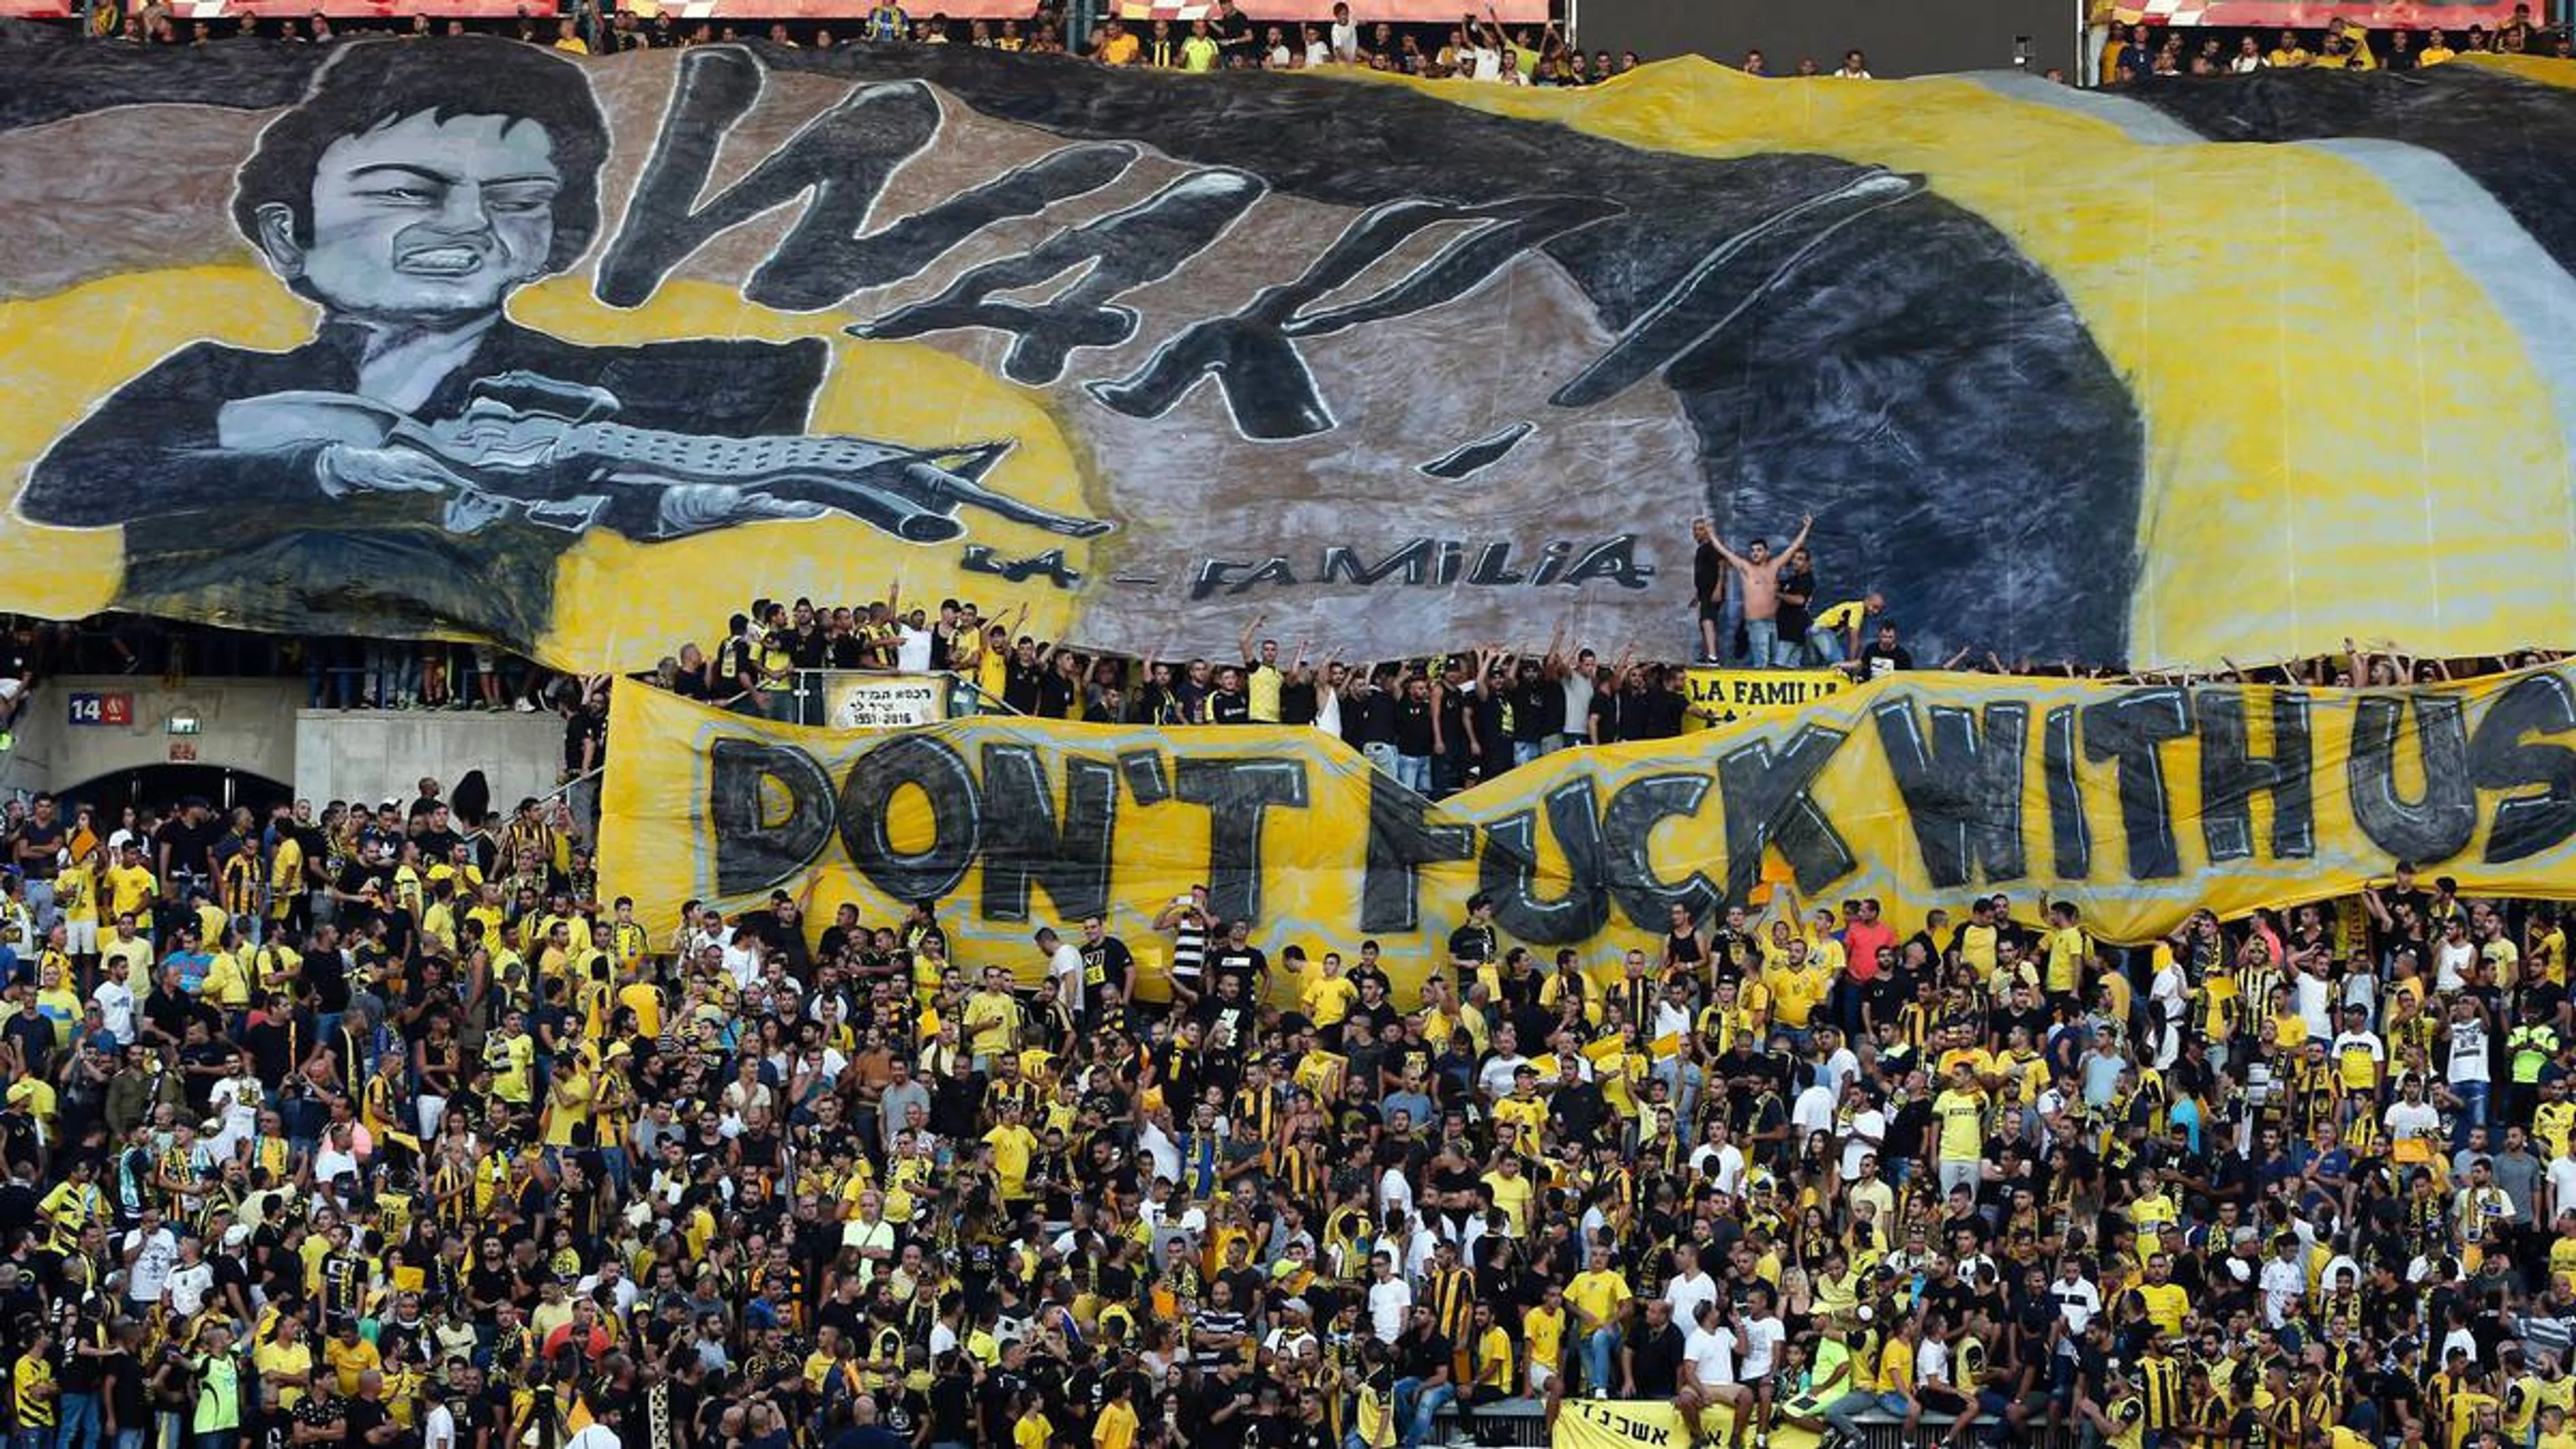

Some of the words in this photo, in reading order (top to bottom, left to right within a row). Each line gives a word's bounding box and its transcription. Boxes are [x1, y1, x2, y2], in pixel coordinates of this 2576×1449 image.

[1690, 678, 1725, 702] LA
[71, 700, 101, 720] 14
[711, 736, 1309, 929] DON'T
[1874, 686, 2316, 887] WITH
